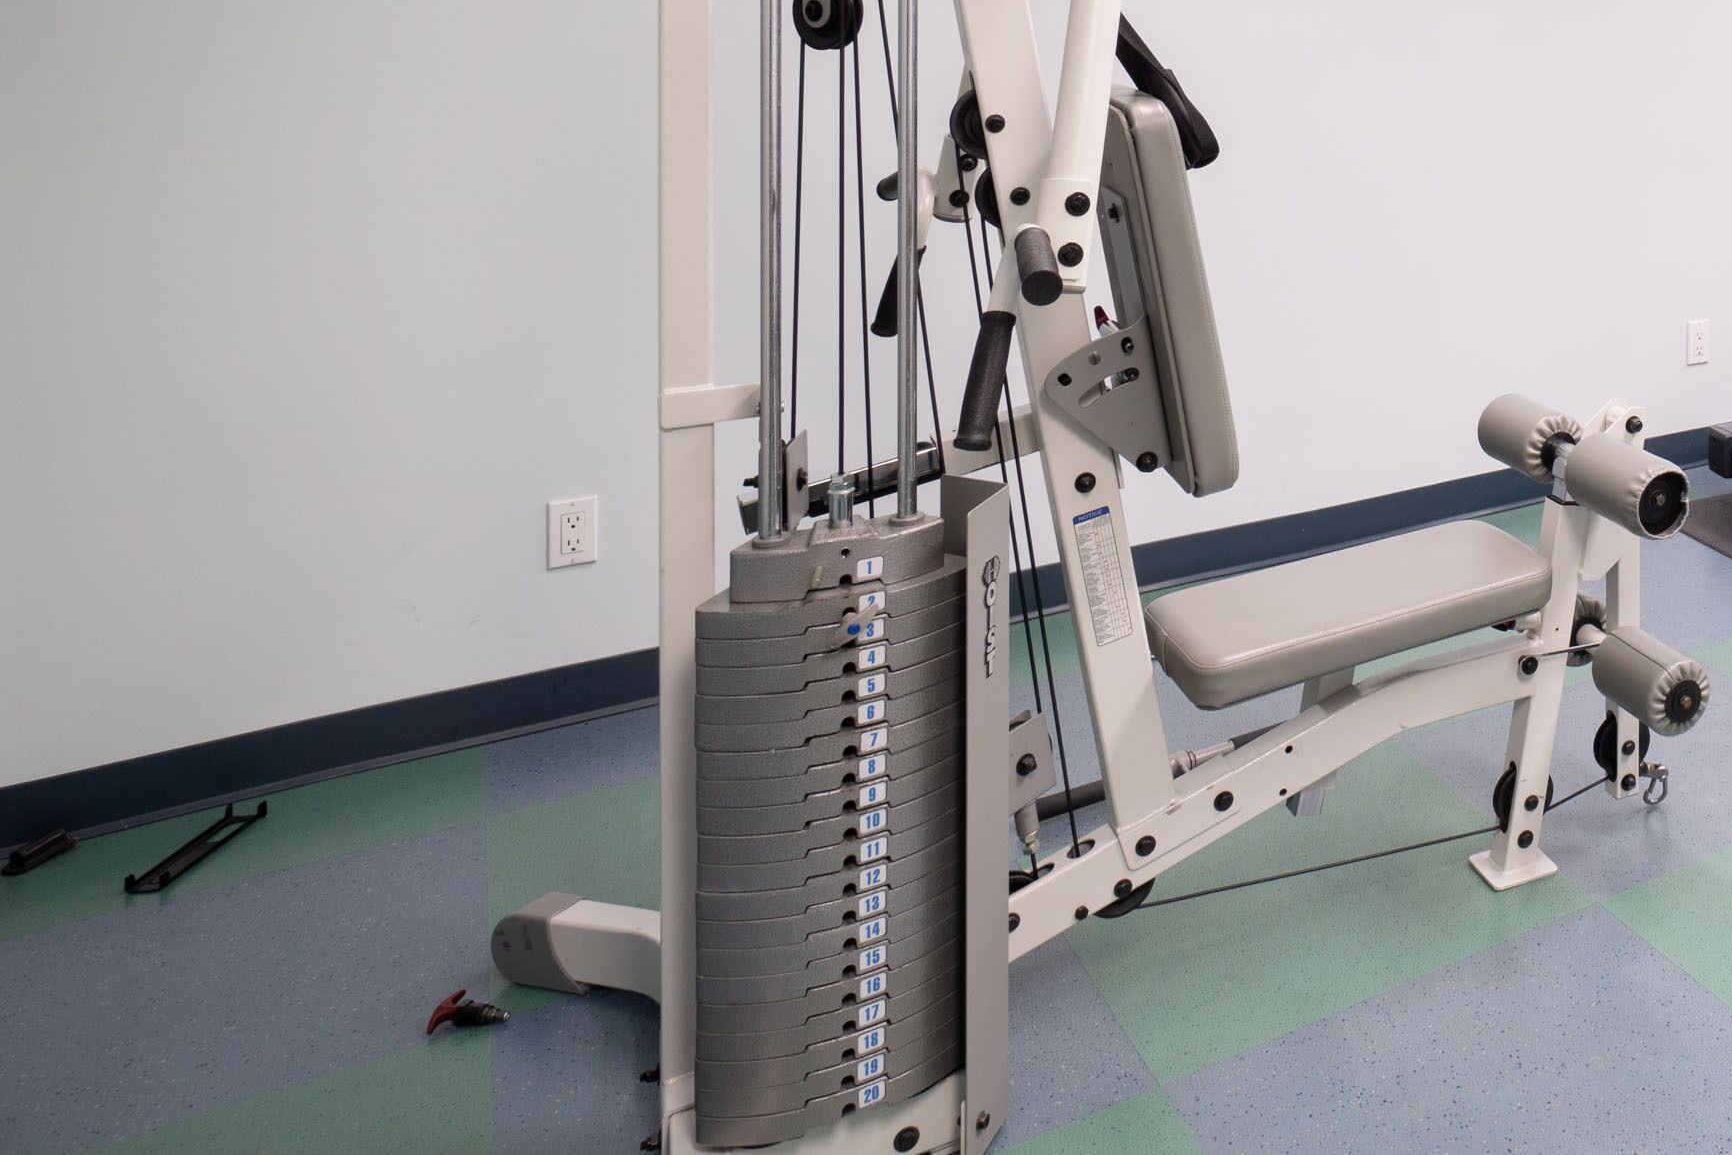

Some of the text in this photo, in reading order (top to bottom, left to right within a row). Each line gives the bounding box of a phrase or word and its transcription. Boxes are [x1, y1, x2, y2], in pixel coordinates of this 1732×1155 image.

[1078, 508, 1104, 522] NOTICE
[865, 560, 873, 575] 1
[981, 554, 1001, 678] HOIST
[866, 622, 875, 638] 3
[867, 650, 876, 665] 4
[866, 678, 876, 693] 5
[866, 705, 875, 720] 6
[868, 732, 878, 747] 7
[867, 759, 877, 774] 8
[867, 787, 877, 802] 9
[865, 813, 881, 830] 10
[865, 842, 880, 858] 11
[865, 868, 881, 885] 12
[864, 894, 880, 912] 13
[865, 921, 881, 939] 14
[865, 949, 880, 965] 15
[865, 976, 881, 993] 16
[864, 1004, 880, 1021] 17
[863, 1030, 879, 1048] 18
[863, 1058, 879, 1076] 19
[863, 1085, 880, 1103] 20
